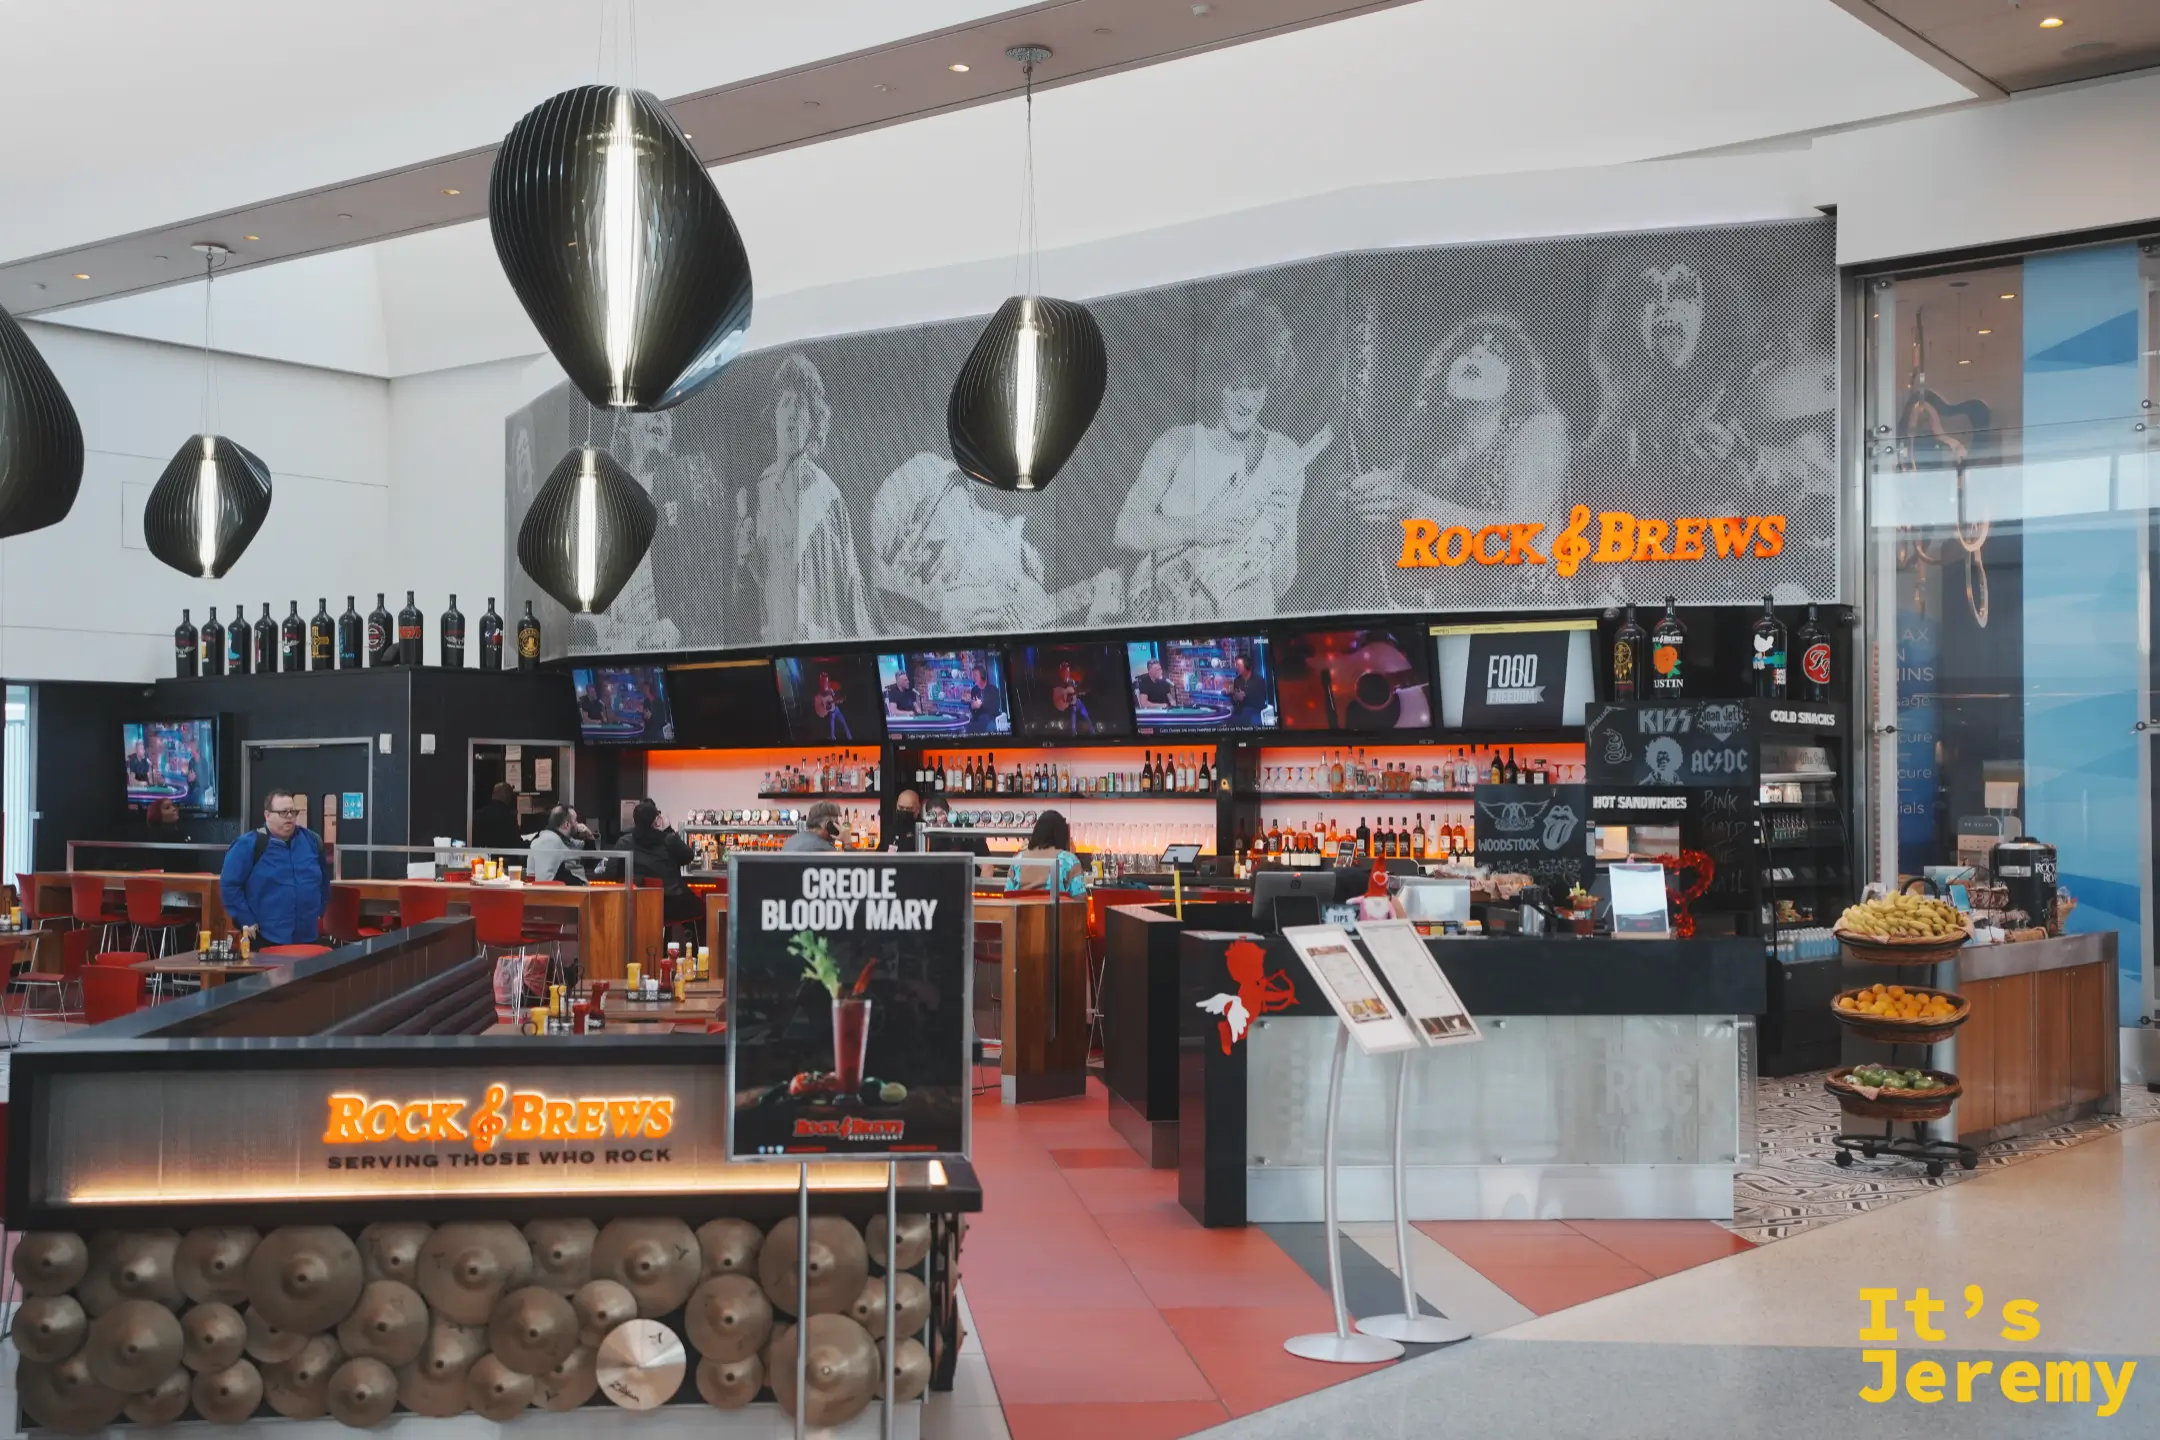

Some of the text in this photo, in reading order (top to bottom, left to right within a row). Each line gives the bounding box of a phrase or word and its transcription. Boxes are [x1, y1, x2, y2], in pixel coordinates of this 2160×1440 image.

[1396, 519, 1547, 568] ROCK
[1591, 511, 1786, 562] BREWS
[1487, 653, 1538, 689] FOOD
[1488, 689, 1536, 703] FREEDOM
[1638, 707, 1693, 734] KISS
[1701, 710, 1721, 722] Joan
[1770, 709, 1836, 726] COLD SNACKS
[1592, 795, 1687, 810] HOT SANDWICHES
[1700, 788, 1738, 816] PINK
[1478, 837, 1540, 852] WOODSTOCK
[802, 868, 897, 899] CREOLE
[761, 899, 938, 931] BLOODY MARY
[1333, 915, 1349, 923] TIPS
[323, 1092, 467, 1144] ROCK
[504, 1090, 674, 1140] BREWS
[327, 1147, 672, 1170] SERVING THOSE WHO ROCK
